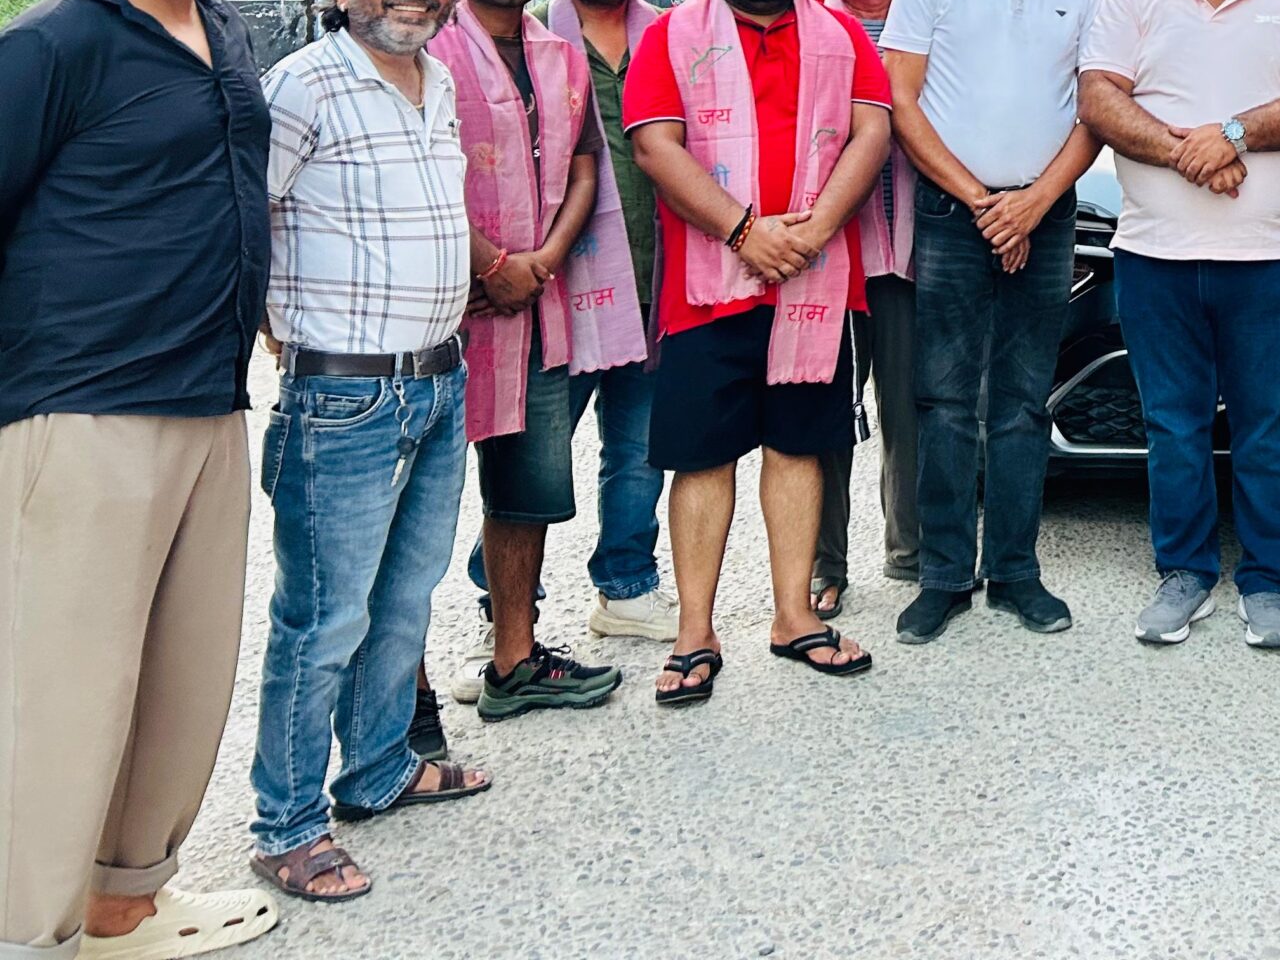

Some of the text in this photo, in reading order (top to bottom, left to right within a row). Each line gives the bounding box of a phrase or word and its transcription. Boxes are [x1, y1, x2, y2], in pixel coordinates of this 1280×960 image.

[698, 107, 732, 127] जय
[571, 285, 615, 313] राम
[786, 303, 828, 324] राम
